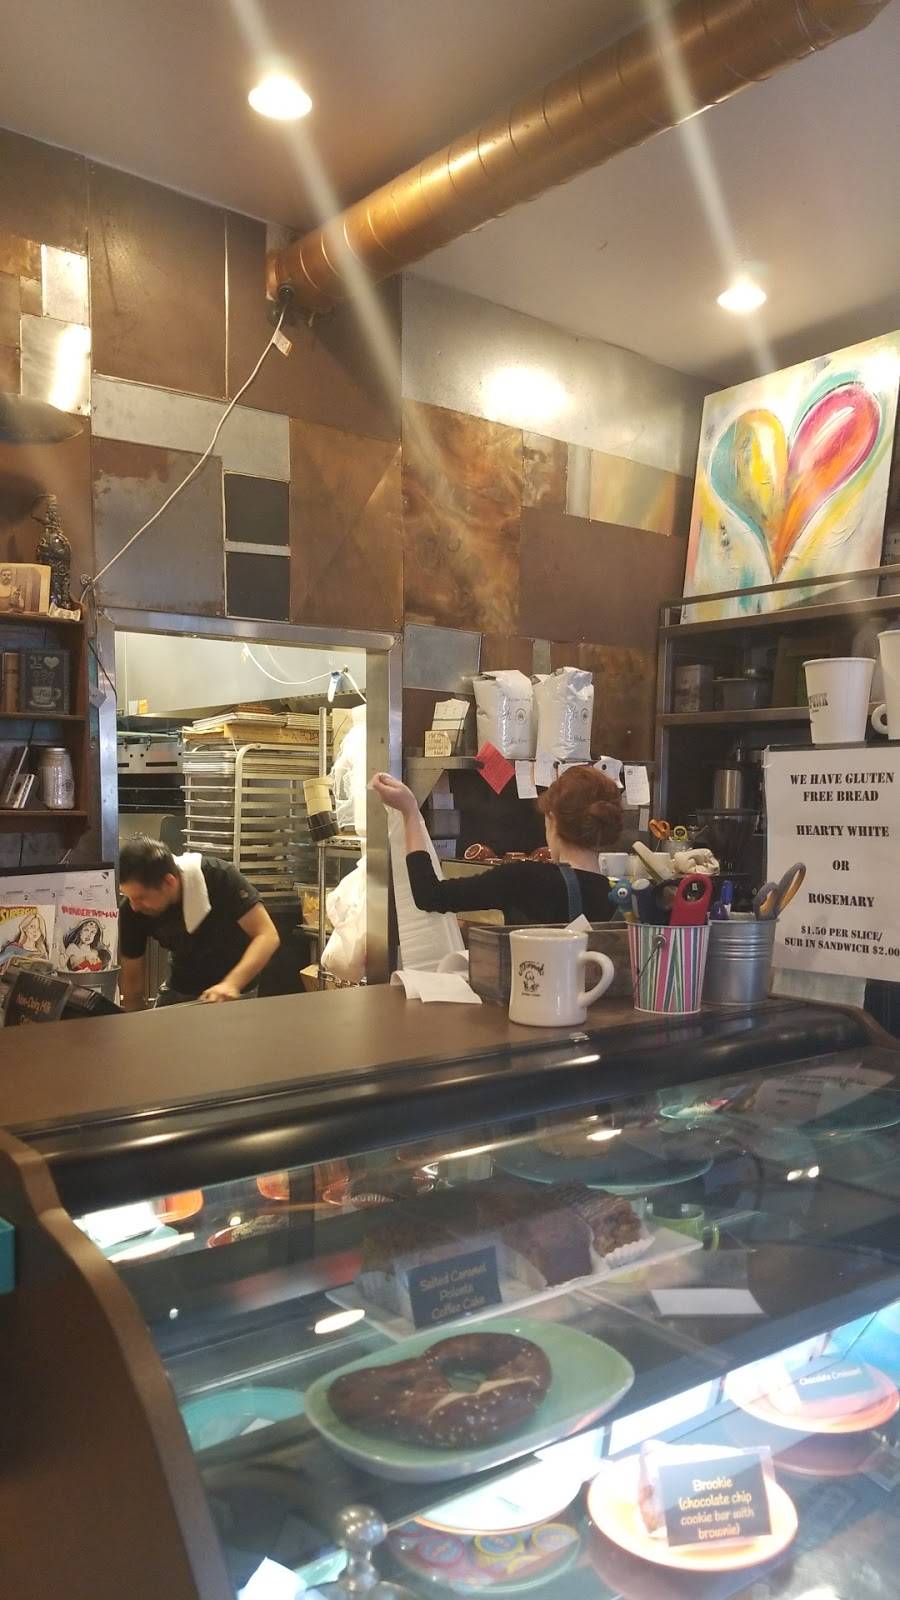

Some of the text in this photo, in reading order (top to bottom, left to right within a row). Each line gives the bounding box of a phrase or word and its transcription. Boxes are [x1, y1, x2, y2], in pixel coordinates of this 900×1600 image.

[790, 772, 894, 785] WE HAVE GLUTEN
[803, 790, 879, 802] FREE BREAD
[796, 825, 889, 837] HEARTY WHITE
[832, 860, 850, 871] OR
[808, 893, 875, 907] ROSEMARY
[800, 925, 883, 942] $1.50 PER SLICE/
[784, 936, 900, 957] SUB IN SANDWICH $2.00
[419, 1262, 487, 1292] Salted Caramel
[431, 1295, 485, 1320] Coffee Cake
[692, 1477, 733, 1492] Brookie
[678, 1491, 752, 1511] (chocolate chip
[680, 1508, 755, 1526] cookie bar with
[698, 1524, 741, 1540] brownie)
